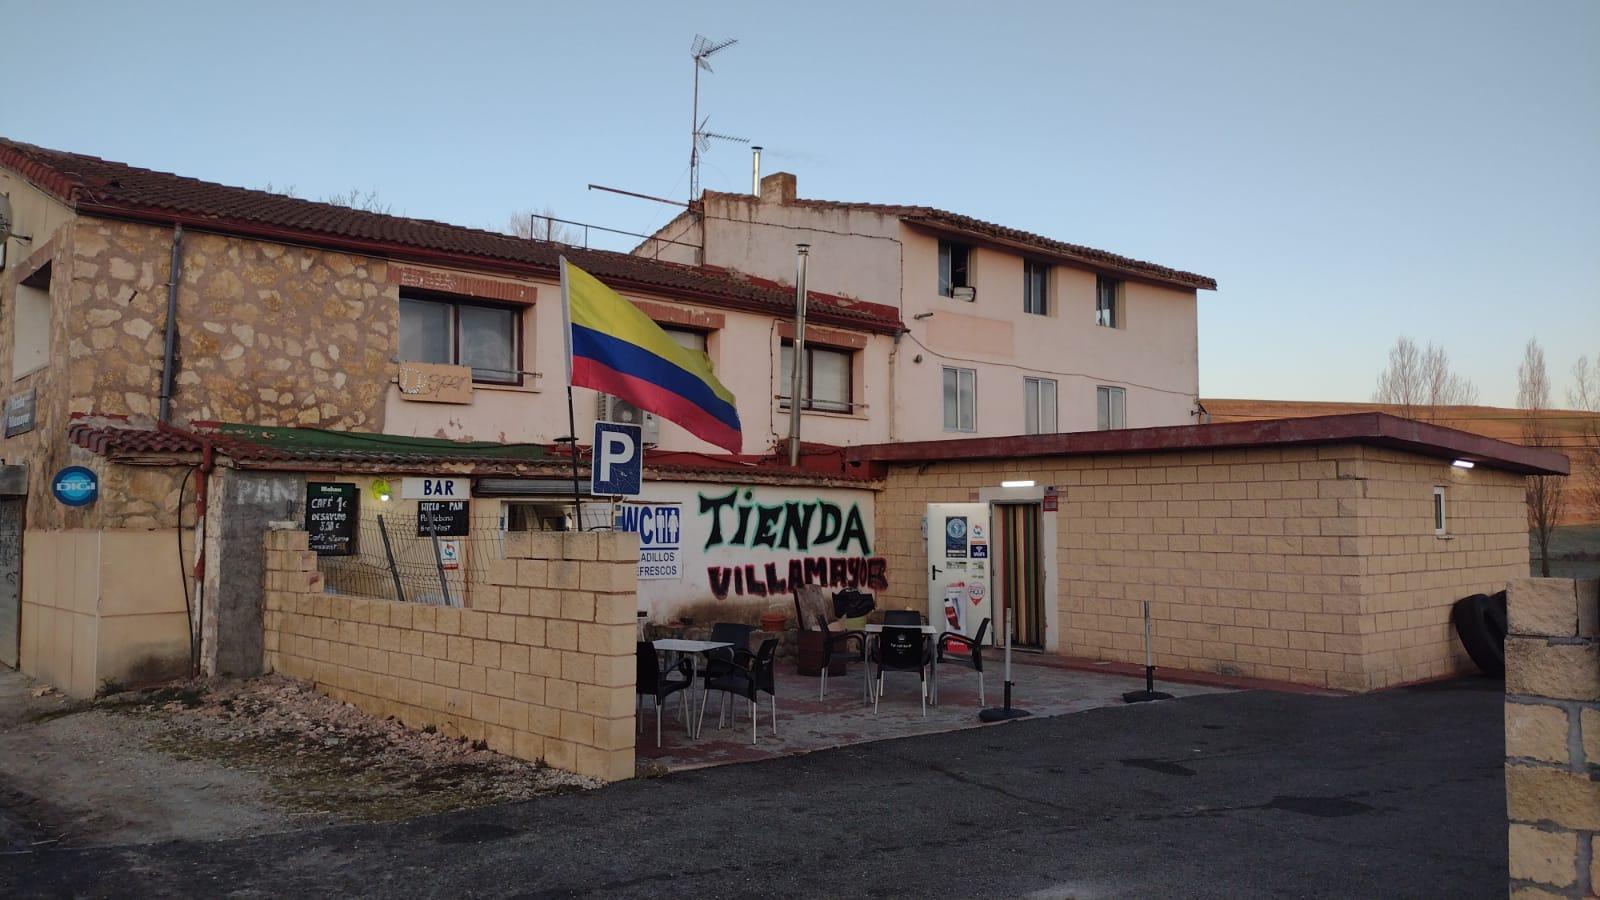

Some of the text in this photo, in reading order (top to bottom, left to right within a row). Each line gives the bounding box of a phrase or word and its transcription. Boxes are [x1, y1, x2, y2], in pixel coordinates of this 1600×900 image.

[600, 431, 634, 482] P
[56, 482, 96, 491] DIGI
[424, 480, 454, 496] BAR
[311, 496, 333, 508] CAFÉ
[449, 502, 464, 511] PAN
[312, 513, 346, 521] DESAYUNO
[622, 506, 654, 544] WC
[707, 556, 888, 600] VILLAMAYOR
